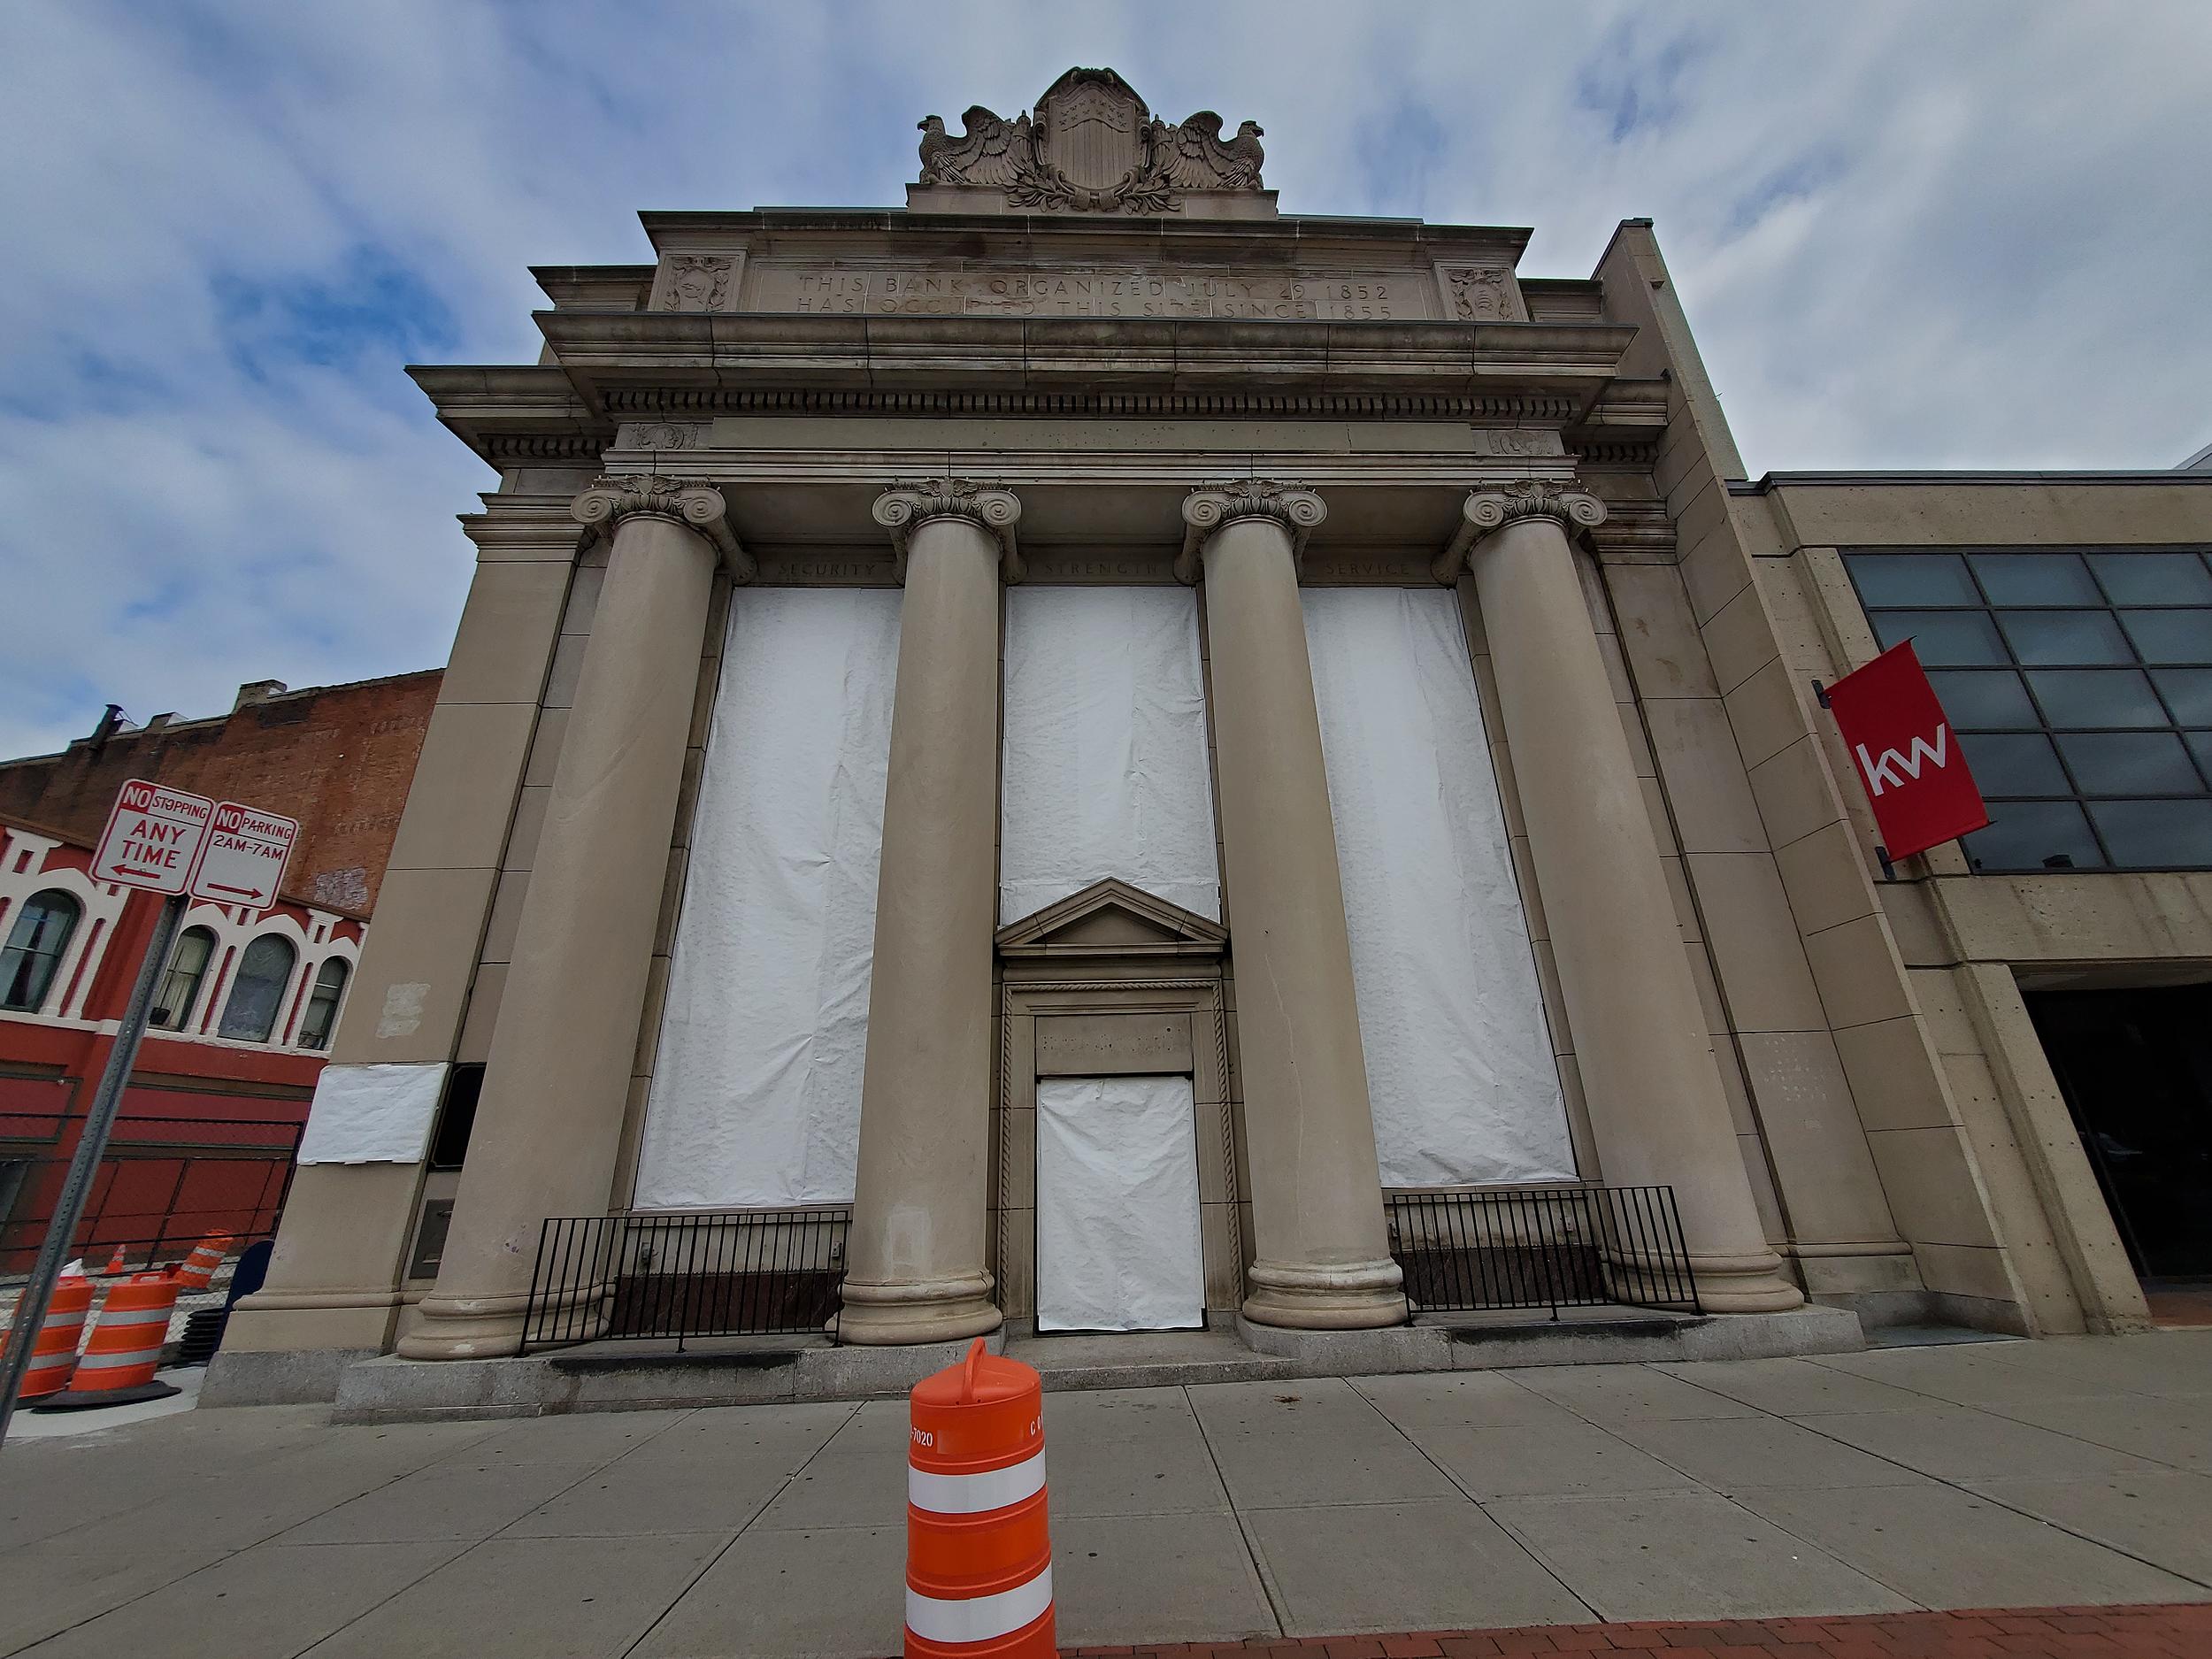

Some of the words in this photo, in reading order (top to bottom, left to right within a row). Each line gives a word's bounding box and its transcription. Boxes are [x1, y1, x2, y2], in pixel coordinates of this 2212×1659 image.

[800, 277, 863, 291] THIS
[887, 278, 963, 292] BANK
[990, 280, 1163, 297] ORGANIZED
[1187, 283, 1253, 297] JULY
[1280, 284, 1305, 299] 29
[1326, 286, 1388, 299] 1852
[798, 297, 854, 312] HAS
[879, 298, 1034, 314] OCCUPIED
[1057, 301, 1120, 317] THIS
[1144, 301, 1201, 317] SITE
[1225, 303, 1307, 319] SINCE
[1330, 305, 1391, 319] 1855
[779, 563, 876, 575] SECURITY
[1045, 565, 1156, 574] STRENGTH
[1325, 564, 1409, 574] SERVICE
[123, 787, 151, 808] NO
[152, 795, 209, 819] STOPPING
[130, 819, 187, 845] ANY
[216, 809, 242, 829] NO
[241, 819, 292, 840] PARKING
[121, 840, 181, 869] TIME
[213, 834, 284, 860] 2AM-7AM
[910, 1424, 933, 1448] -7020
